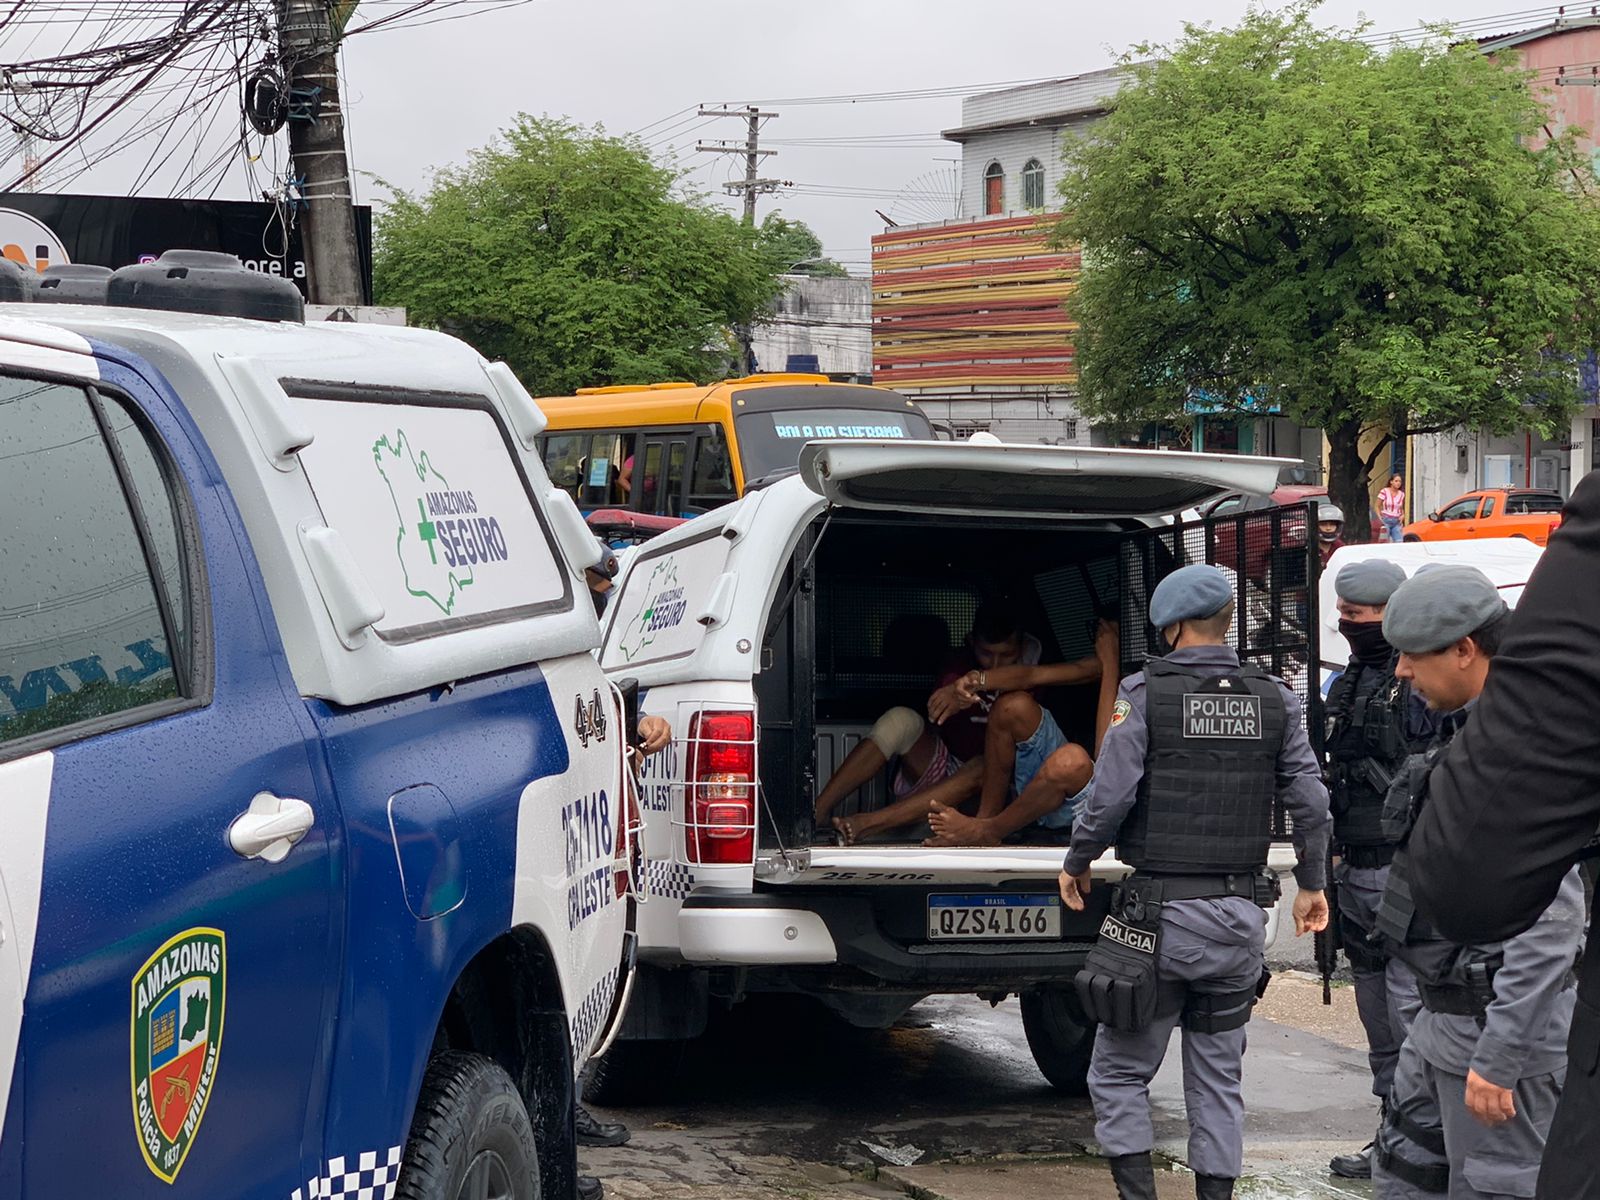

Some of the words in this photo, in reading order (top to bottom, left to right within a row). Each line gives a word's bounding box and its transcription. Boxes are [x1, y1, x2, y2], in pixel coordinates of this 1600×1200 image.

[425, 490, 477, 516] AMAZONAS
[436, 516, 507, 568] SEGURO
[656, 586, 684, 604] AMAZONAS
[647, 600, 687, 632] SEGURO
[1190, 697, 1256, 717] POLÍCIA
[1190, 718, 1256, 735] MILITAR
[651, 785, 672, 812] LEST
[562, 789, 612, 879] 25-7118
[580, 865, 611, 920] LESTE
[940, 908, 1047, 935] QZS4I66
[1103, 921, 1152, 950] POLÍCIA
[137, 941, 220, 1019] AMAZONAS
[184, 1041, 216, 1139] Militar
[137, 1078, 161, 1159] Polícia
[163, 1142, 181, 1170] 1837
